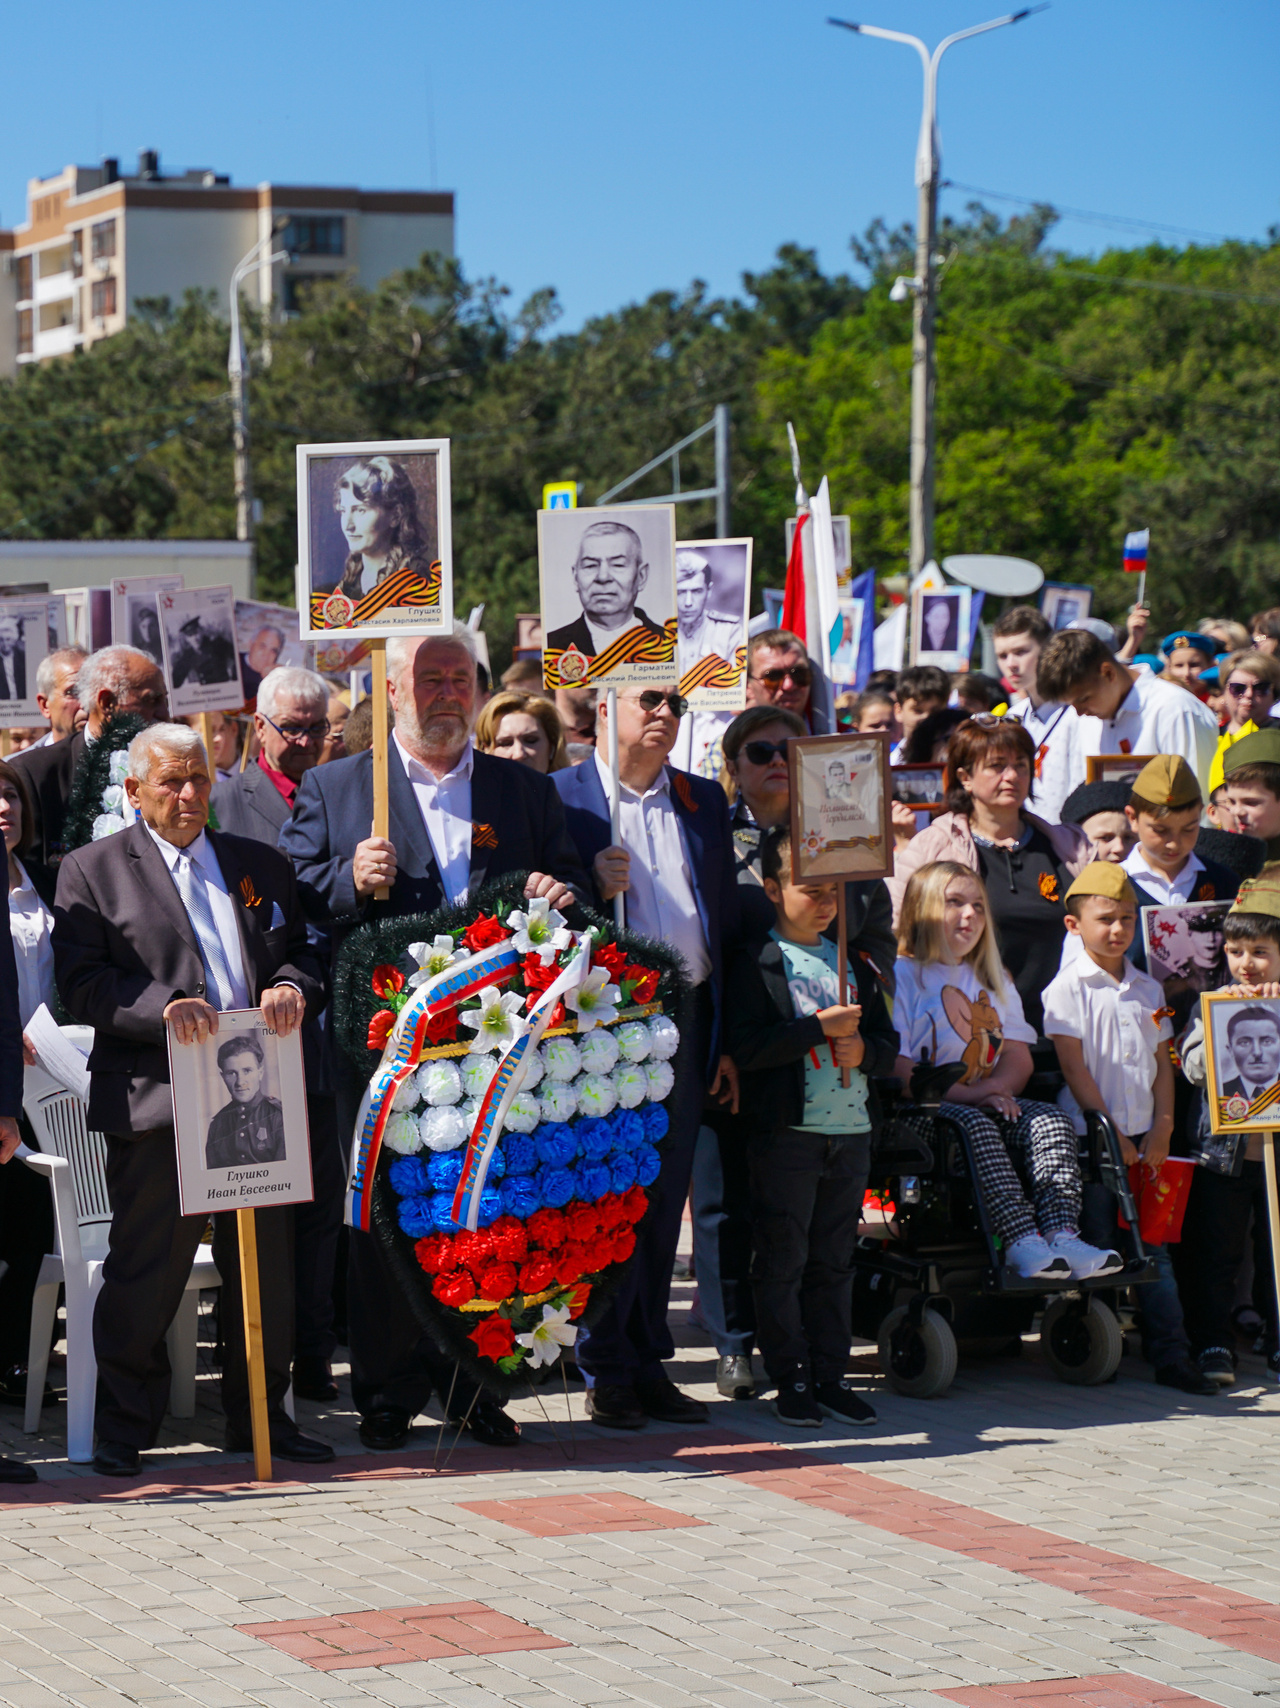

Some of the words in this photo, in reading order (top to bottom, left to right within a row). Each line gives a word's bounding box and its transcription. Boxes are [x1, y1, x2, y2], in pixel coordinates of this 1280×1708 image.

[408, 607, 441, 615] Глушко
[633, 664, 675, 672] Гарматин
[590, 675, 625, 683] Василий
[628, 674, 676, 682] Леонтьевич
[227, 1168, 269, 1183] Глушко
[207, 1187, 237, 1200] Иван
[239, 1182, 292, 1196] Евсеевич
